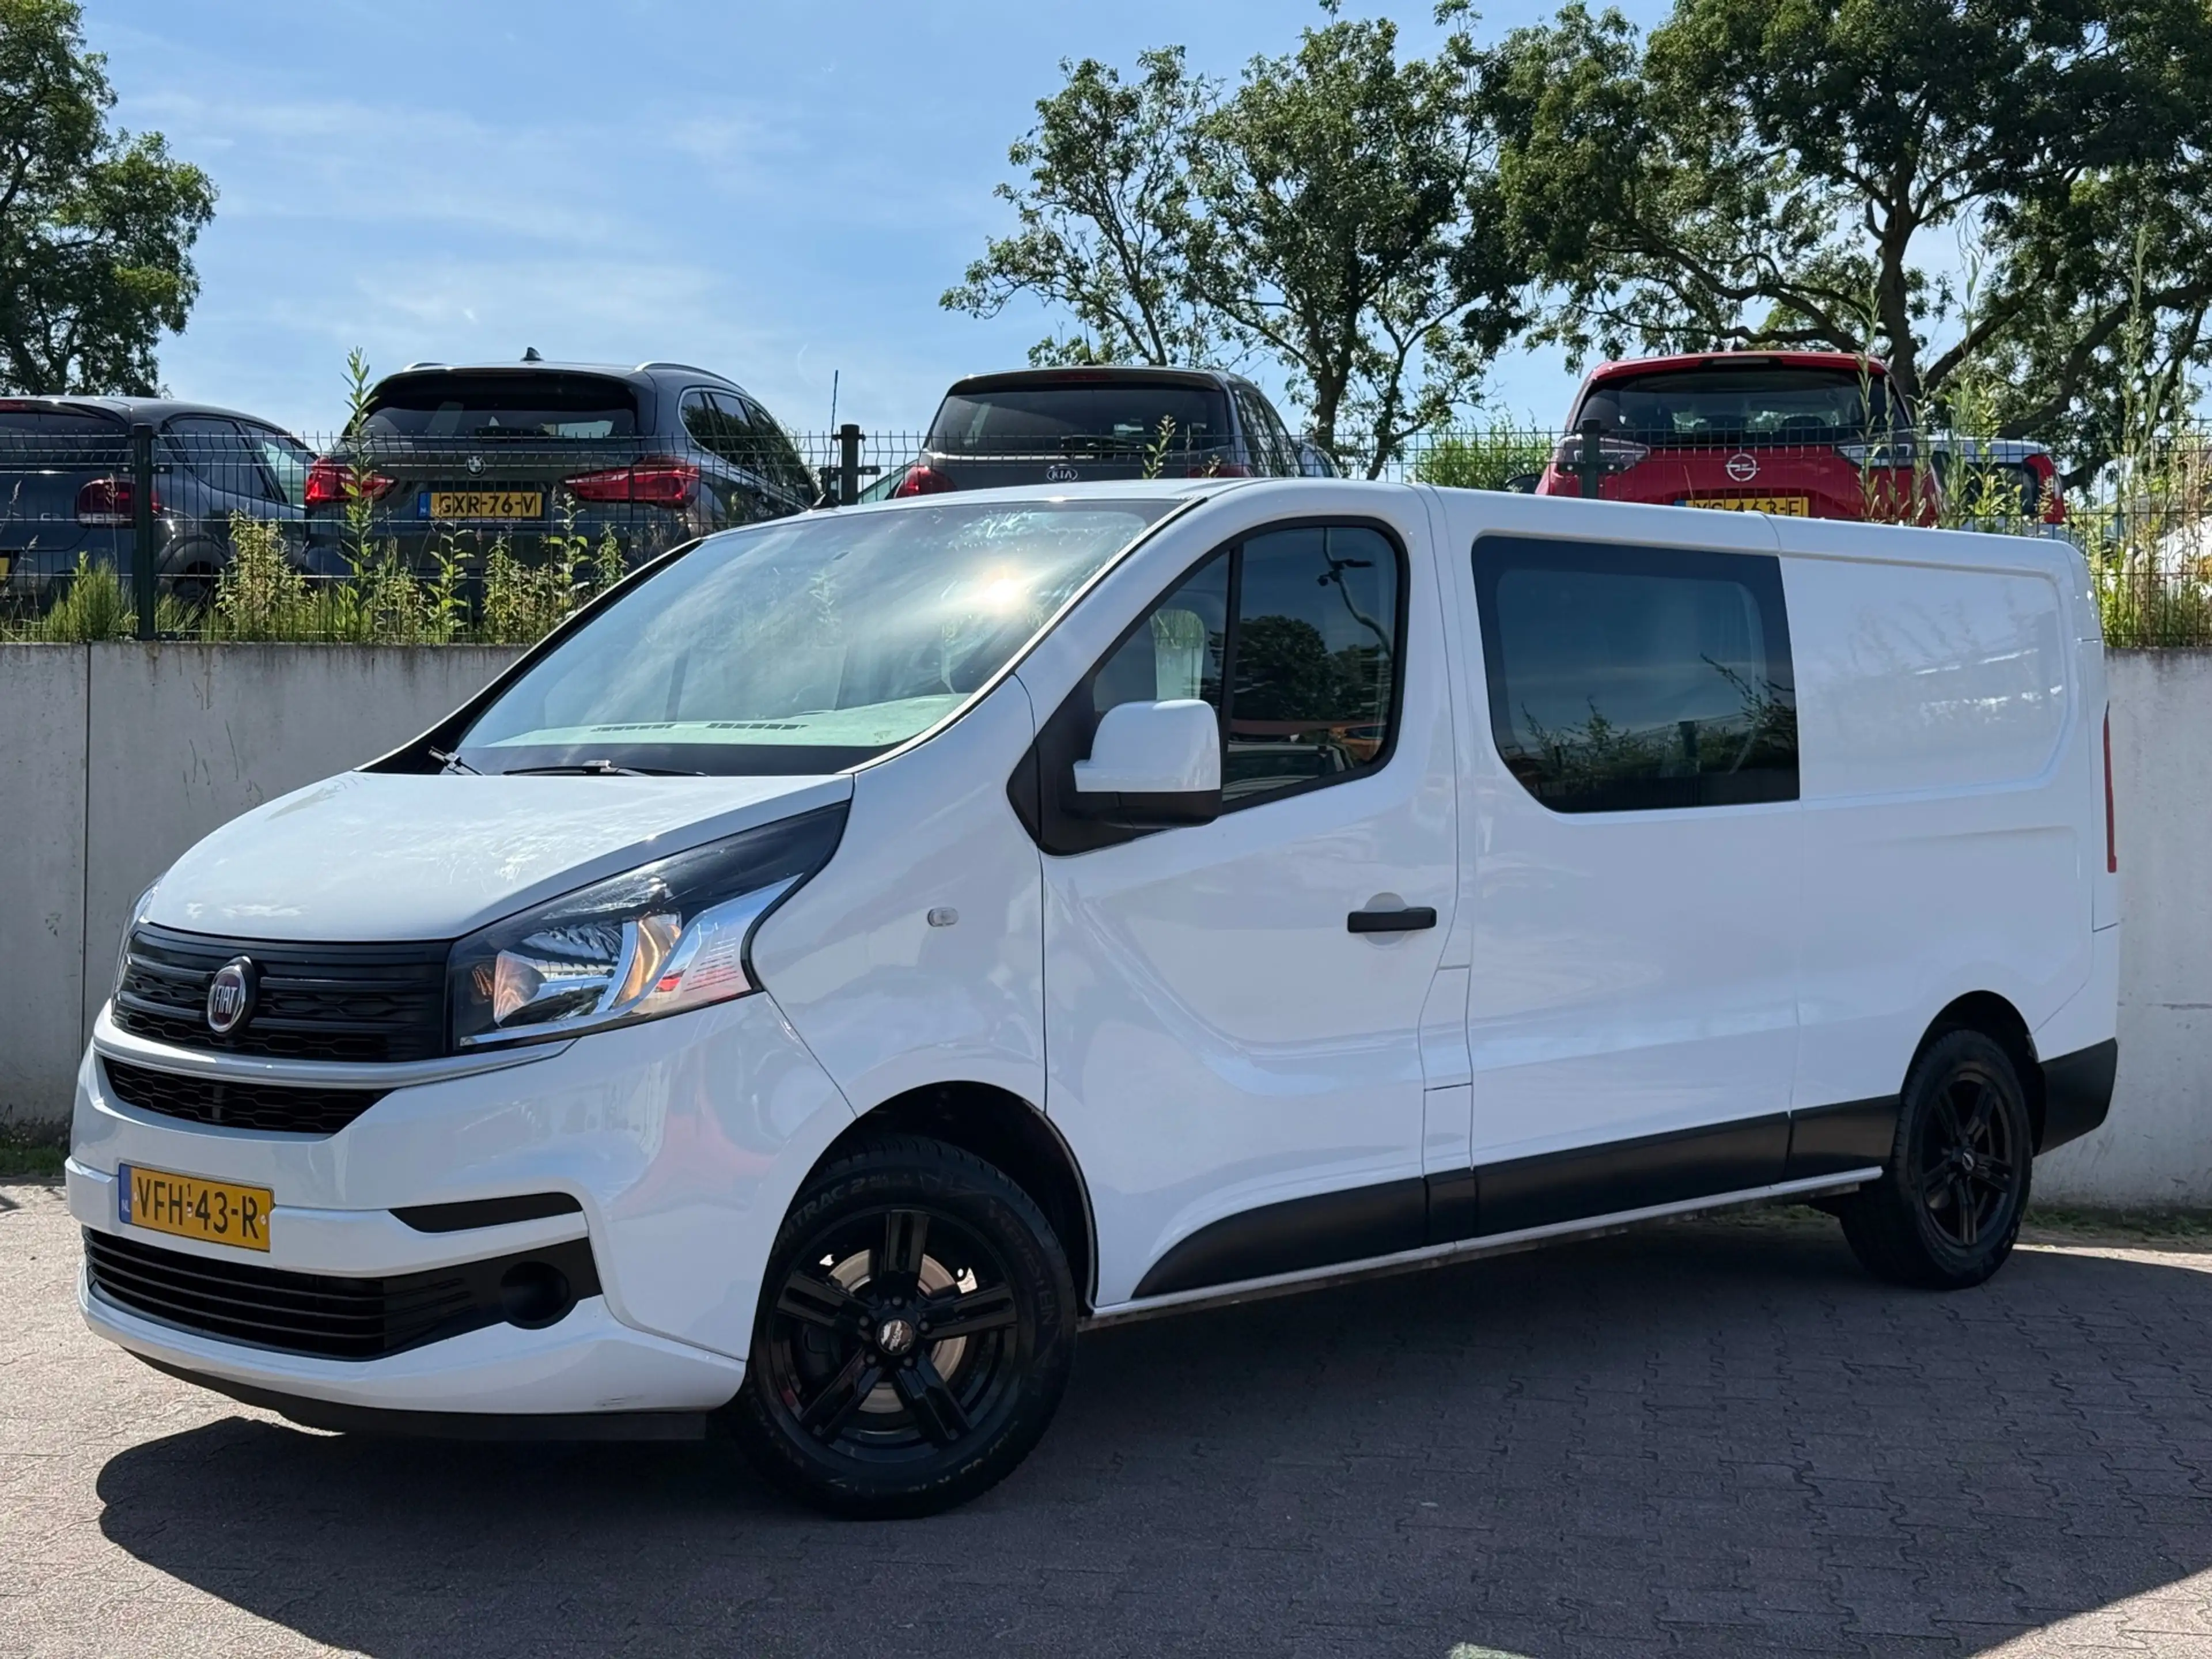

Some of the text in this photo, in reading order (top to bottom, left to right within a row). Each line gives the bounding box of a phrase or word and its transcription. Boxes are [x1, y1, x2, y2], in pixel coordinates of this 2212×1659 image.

[1052, 470, 1071, 479] KIA
[440, 495, 535, 514] GXR-76-V
[214, 985, 238, 1014] FIAT
[121, 1198, 130, 1213] NL
[137, 1176, 260, 1239] VFH-43-R
